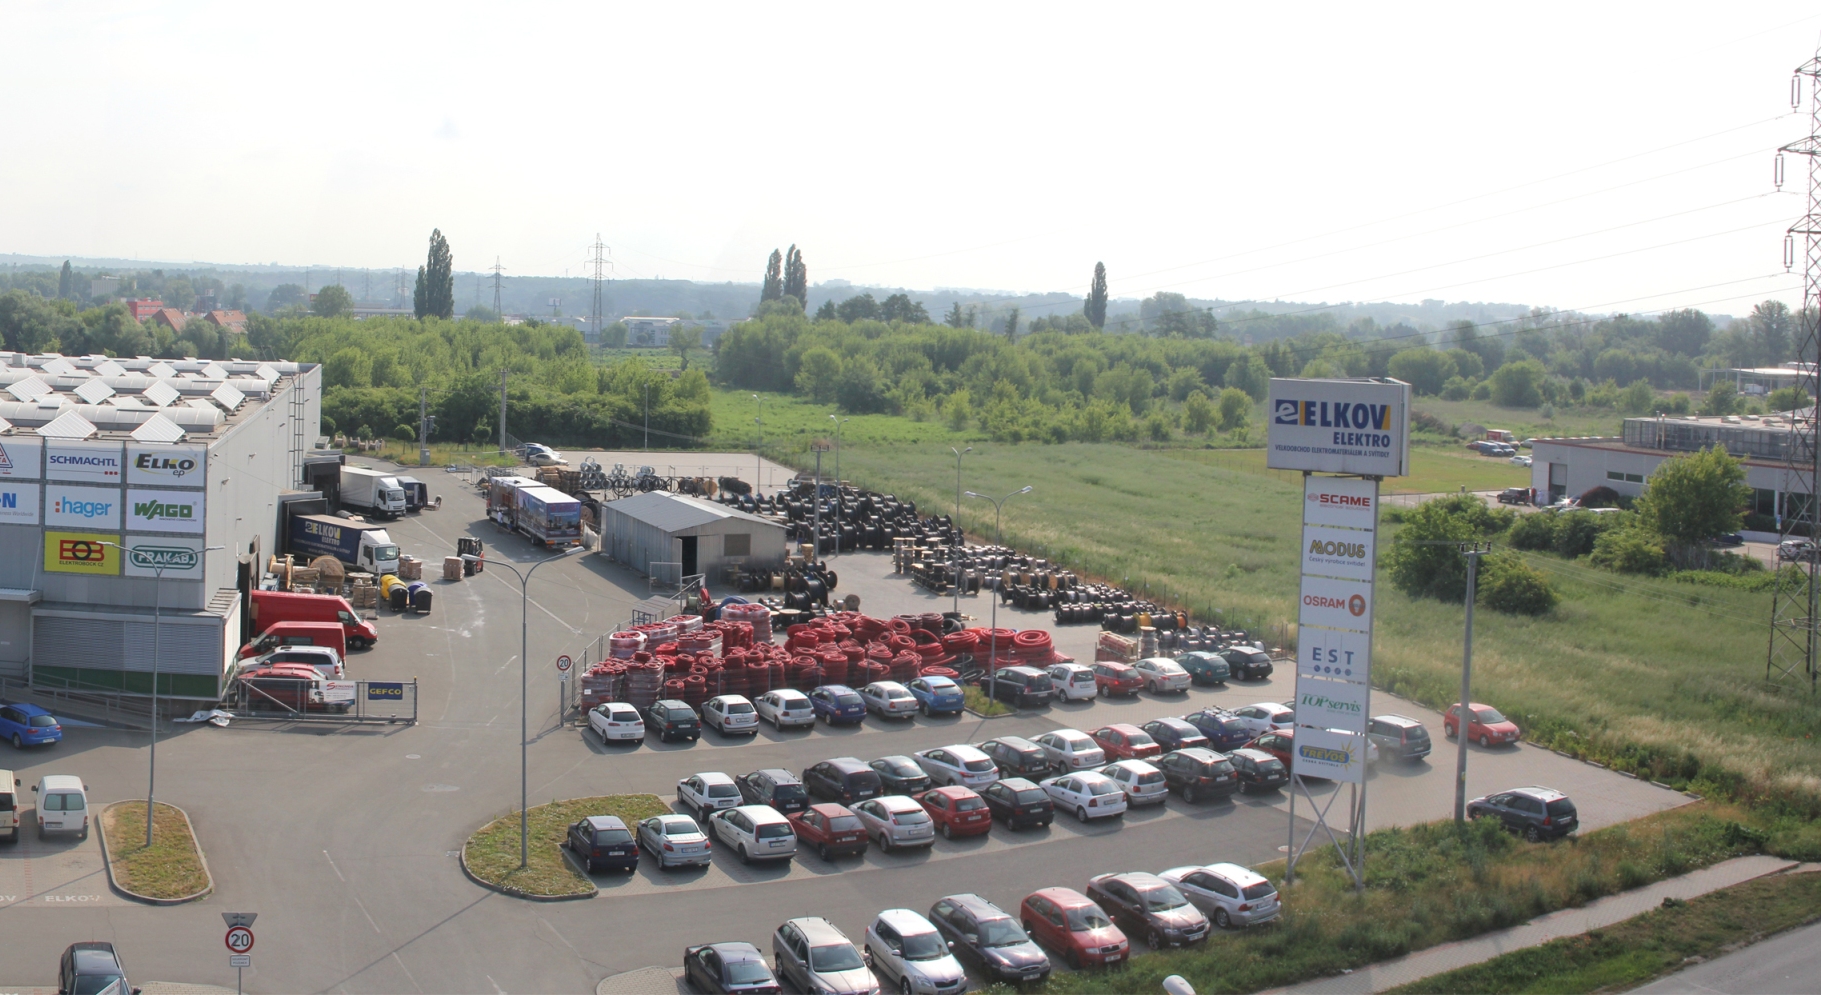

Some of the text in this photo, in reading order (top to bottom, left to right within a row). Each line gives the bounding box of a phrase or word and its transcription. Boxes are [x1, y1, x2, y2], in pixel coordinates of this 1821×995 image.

[1302, 401, 1390, 430] ELKOV
[1333, 432, 1390, 448] ELEKTRO
[1275, 444, 1310, 453] VELKOOBCHOD
[50, 456, 118, 467] SCHMACHTL
[173, 469, 185, 478] ep
[62, 496, 112, 518] hager
[1320, 493, 1370, 507] SCAME
[134, 499, 193, 520] WAGO
[1309, 539, 1366, 558] MODUS
[138, 551, 190, 564] PRAKAB
[1303, 595, 1345, 609] OSRAM
[560, 659, 568, 667] 20
[231, 934, 249, 946] 20
